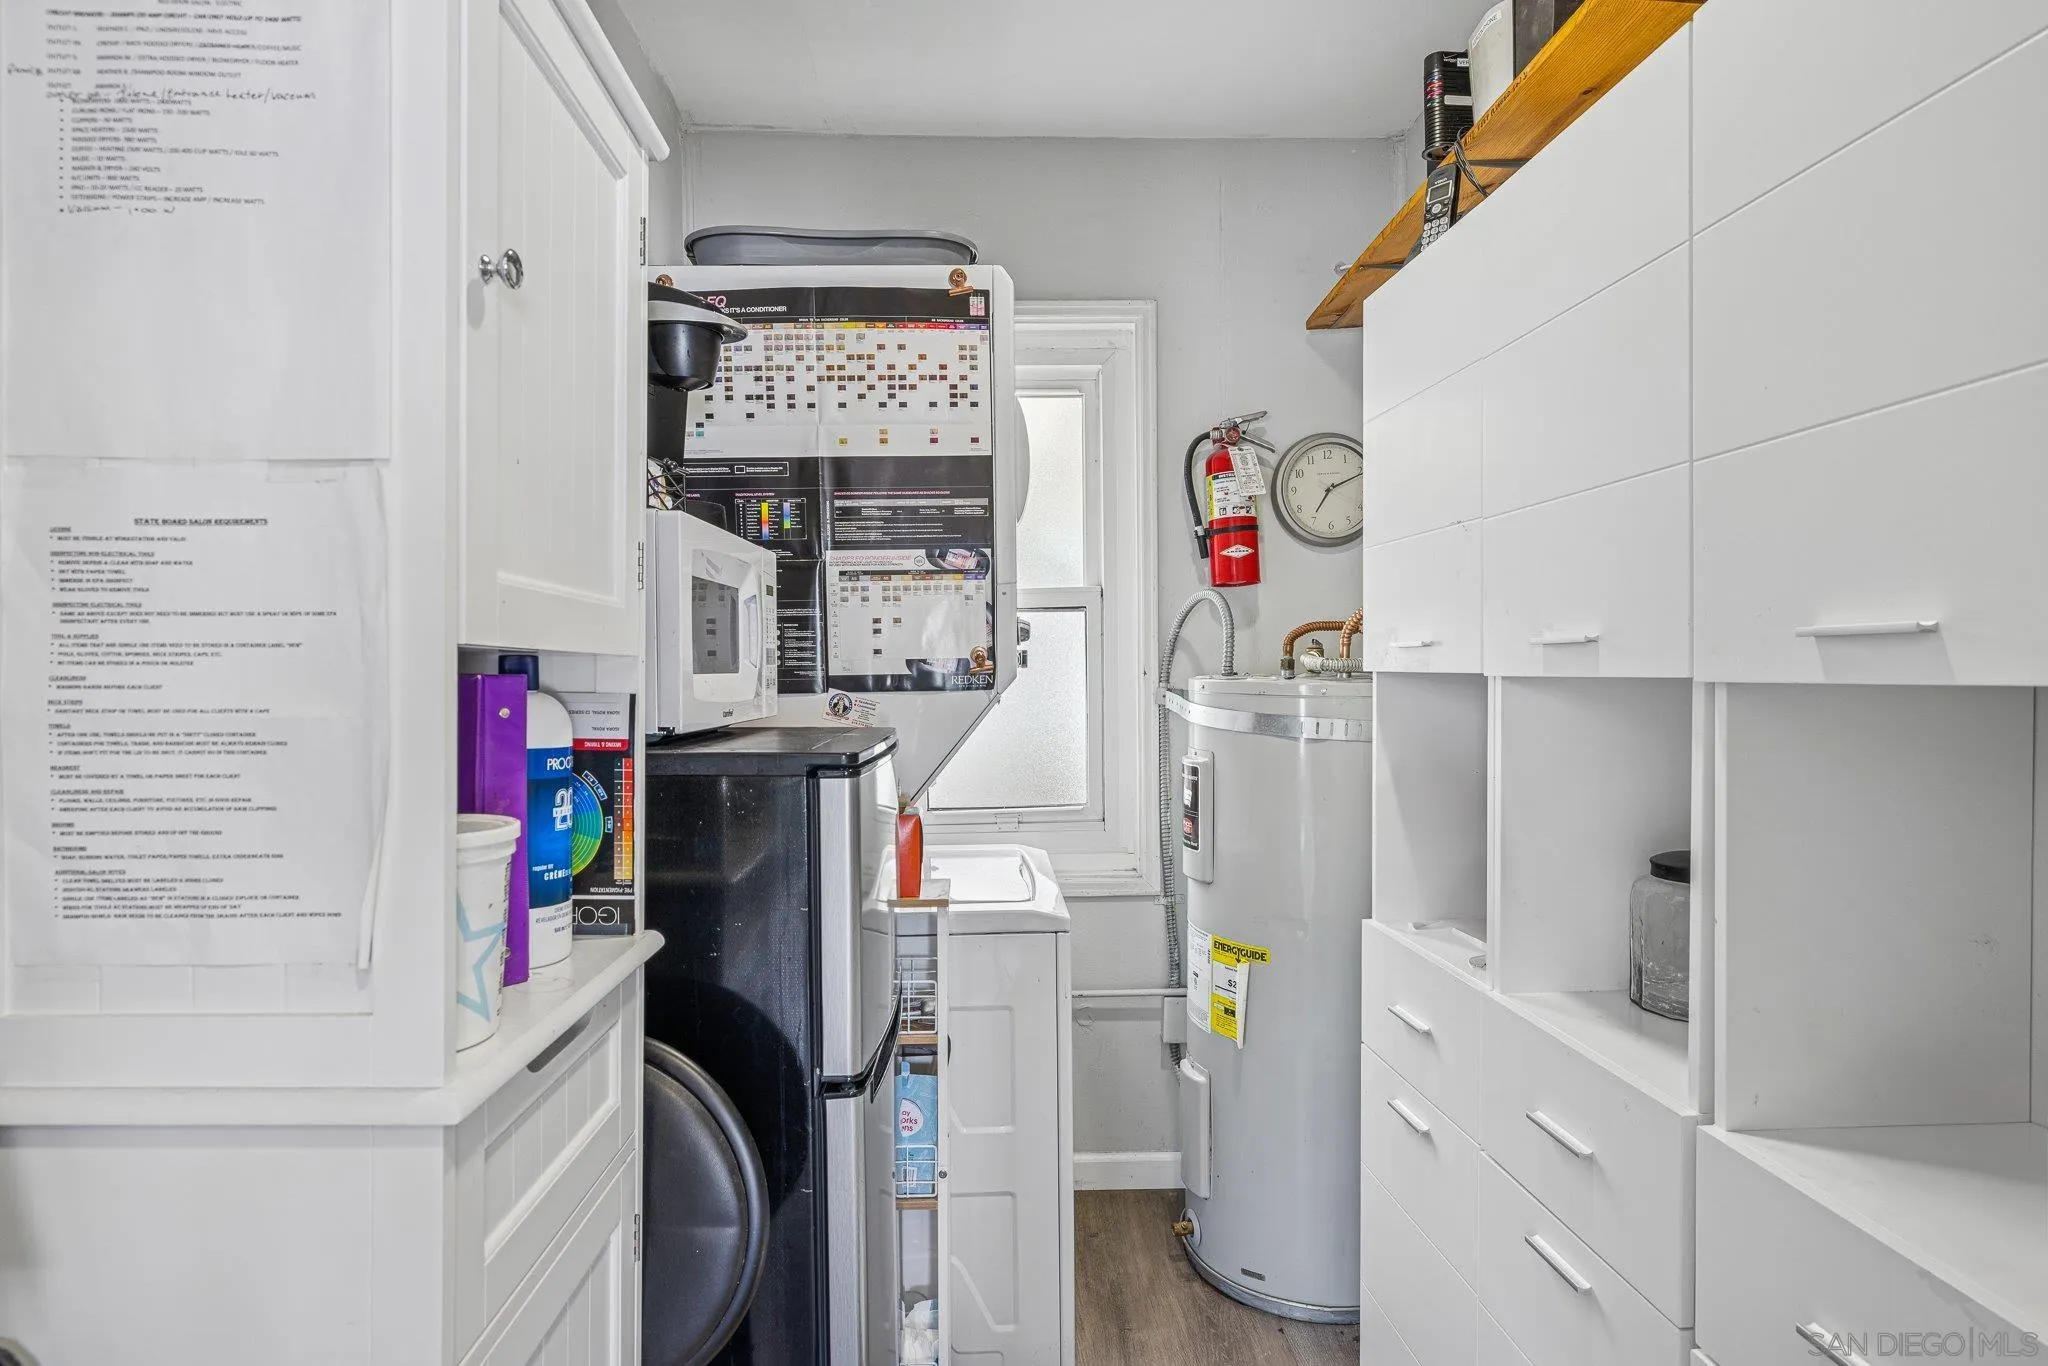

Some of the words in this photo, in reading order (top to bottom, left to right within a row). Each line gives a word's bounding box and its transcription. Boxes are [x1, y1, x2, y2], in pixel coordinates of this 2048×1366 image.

[1323, 450, 1332, 460] 12
[1307, 456, 1314, 464] 11
[1295, 469, 1304, 478] 10
[1291, 486, 1297, 495] 9
[1297, 505, 1302, 513] 8
[134, 518, 159, 526] STATE
[214, 518, 268, 526] REQUIREMENTS
[1312, 516, 1317, 525] 7
[1346, 516, 1351, 525] 5
[1328, 521, 1334, 530] 6
[952, 675, 993, 684] REDKEN
